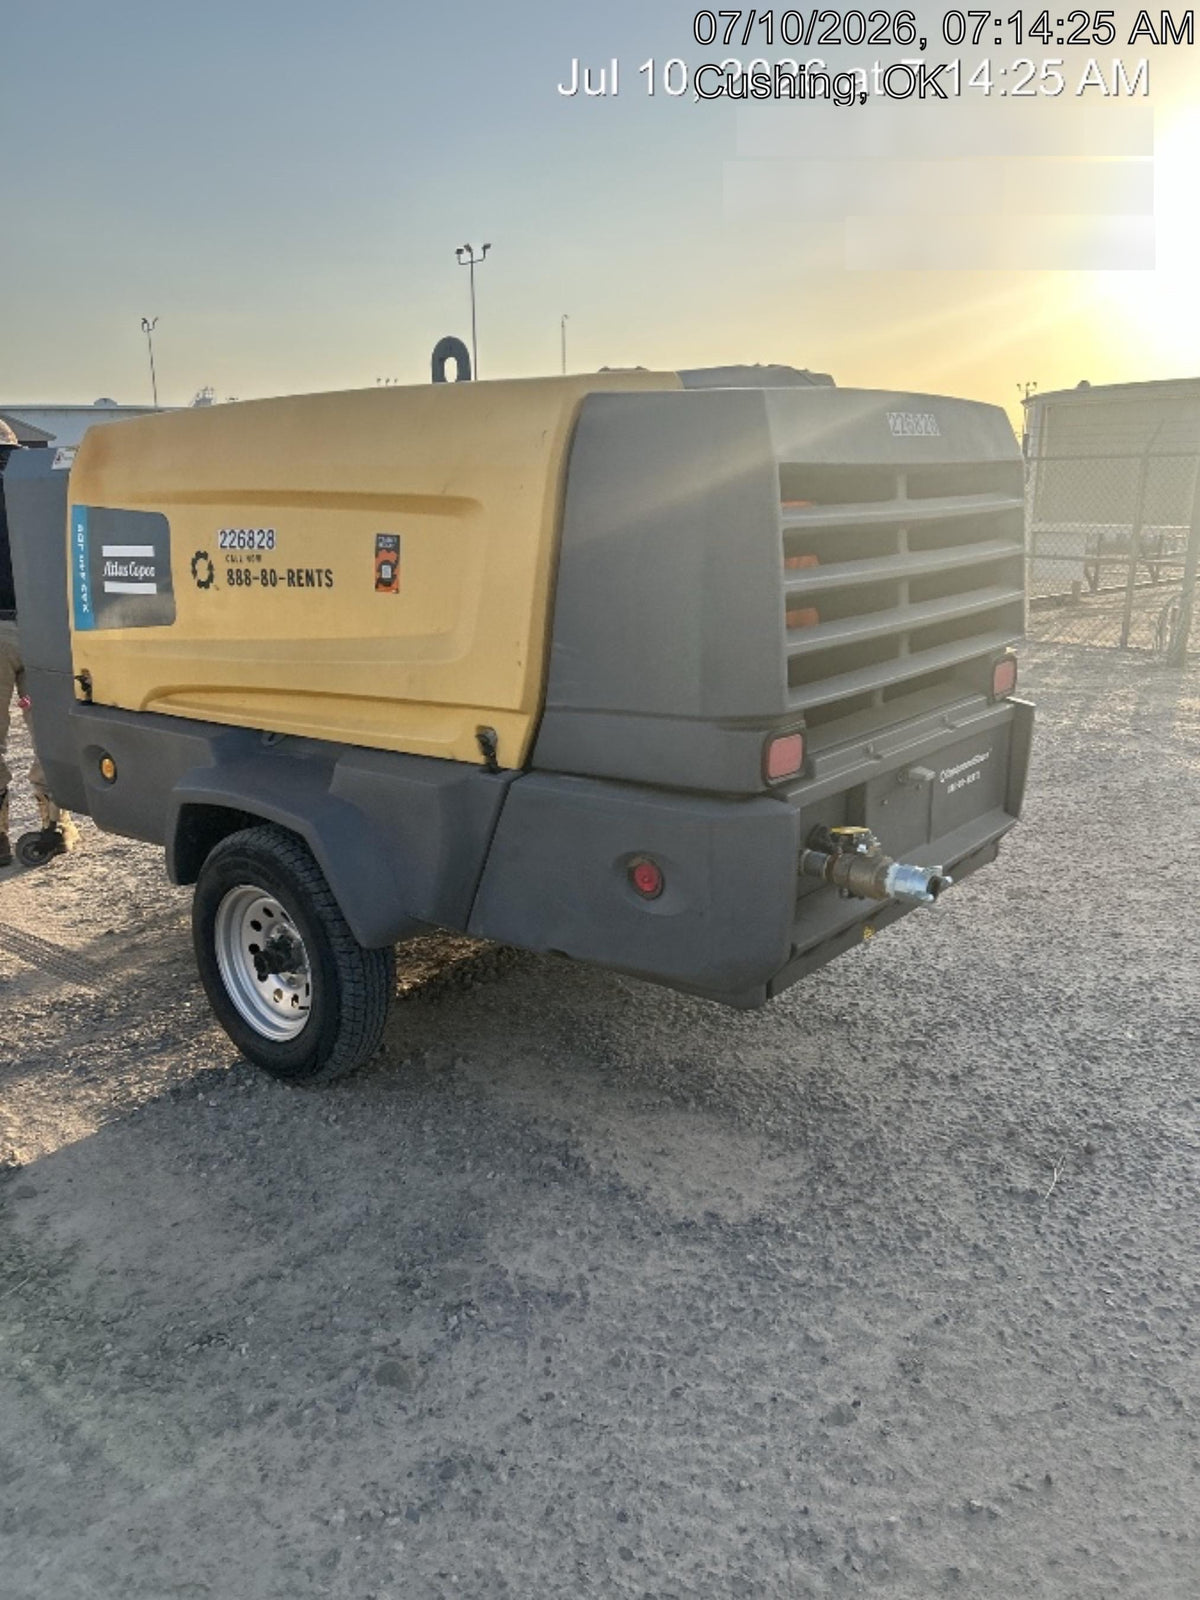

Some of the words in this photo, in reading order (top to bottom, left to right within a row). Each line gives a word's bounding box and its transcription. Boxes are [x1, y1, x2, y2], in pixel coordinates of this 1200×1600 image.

[219, 528, 275, 549] 226828
[102, 561, 128, 577] Atlas
[227, 568, 334, 587] 888-80-RENTS
